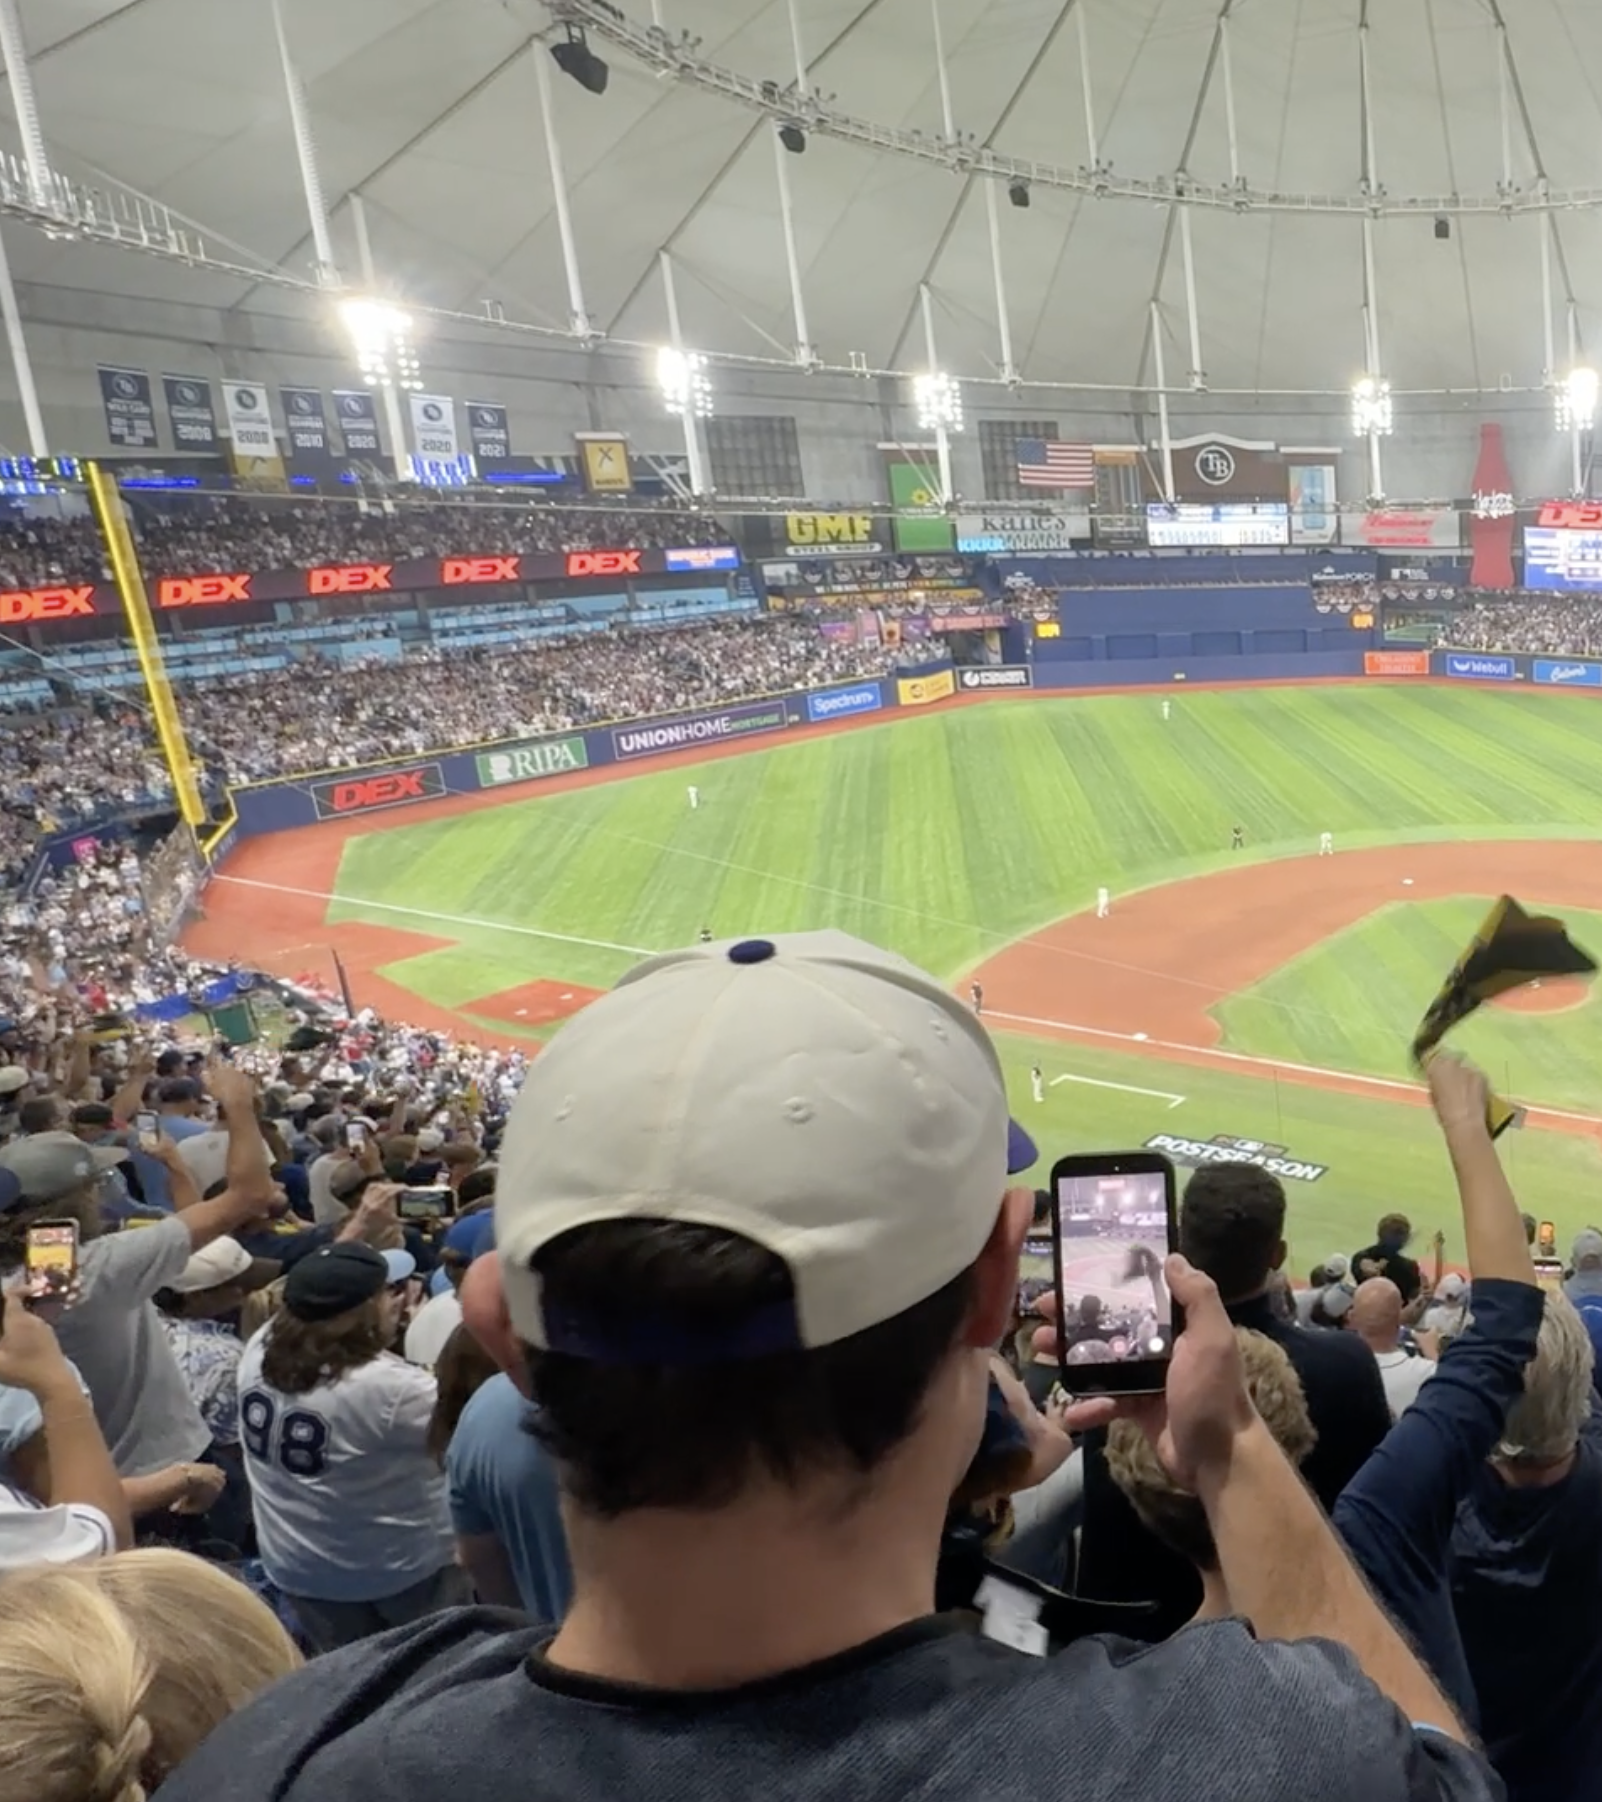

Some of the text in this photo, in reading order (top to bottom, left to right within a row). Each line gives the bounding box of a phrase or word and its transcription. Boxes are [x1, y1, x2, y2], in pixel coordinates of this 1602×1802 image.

[347, 435, 376, 448] 2020
[422, 438, 451, 451] 2020
[479, 444, 505, 457] 2021
[1203, 453, 1229, 477] TB
[786, 511, 872, 544] GMF
[443, 556, 520, 584] DEX
[567, 550, 641, 576] DEX
[161, 574, 251, 607] DEX
[309, 564, 393, 594] DEX
[0, 586, 95, 623] DEX
[1472, 660, 1507, 674] Webull
[814, 692, 874, 714] Spectrum
[514, 743, 578, 778] RIPA
[332, 770, 426, 812] DEX
[1147, 1134, 1323, 1181] POSTSEASON
[240, 1389, 326, 1476] 98
